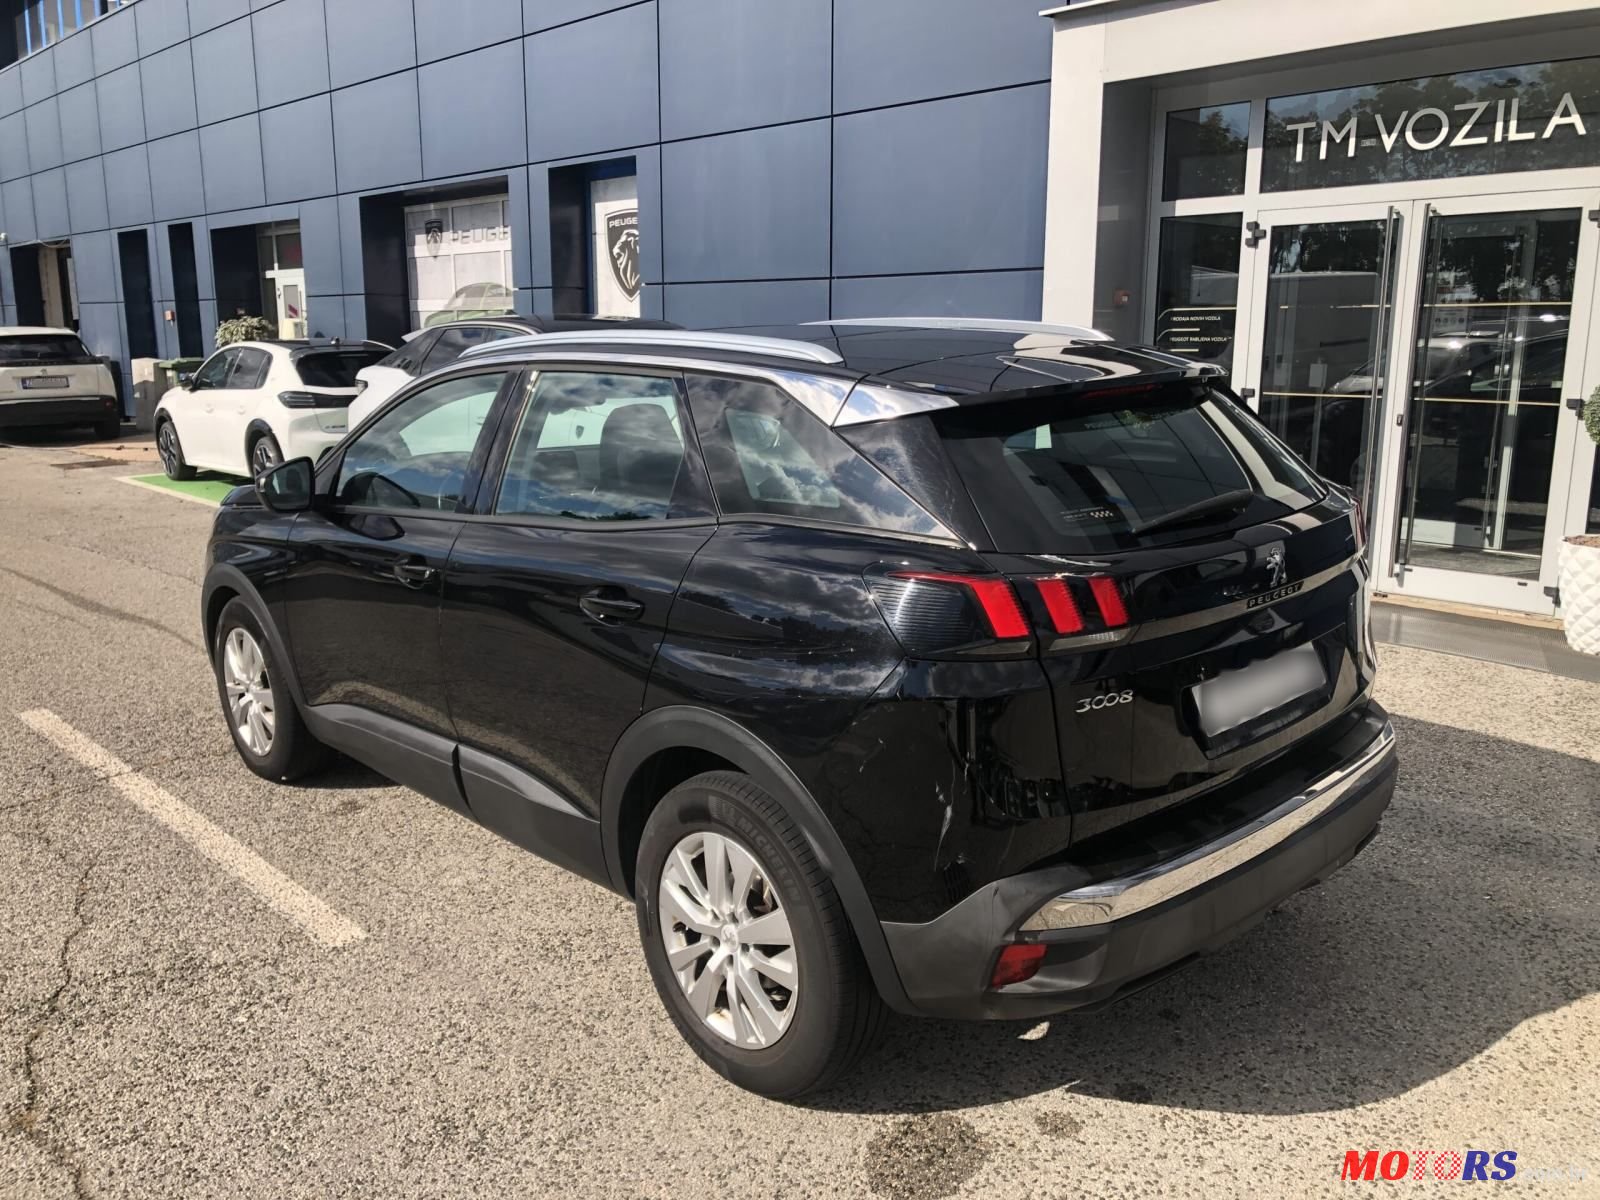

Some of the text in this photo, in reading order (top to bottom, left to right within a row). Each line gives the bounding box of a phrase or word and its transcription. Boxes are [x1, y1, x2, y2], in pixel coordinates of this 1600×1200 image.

[1286, 92, 1587, 162] TM VOZILA
[1249, 584, 1301, 608] PEUGEOT
[1075, 689, 1134, 713] 3008
